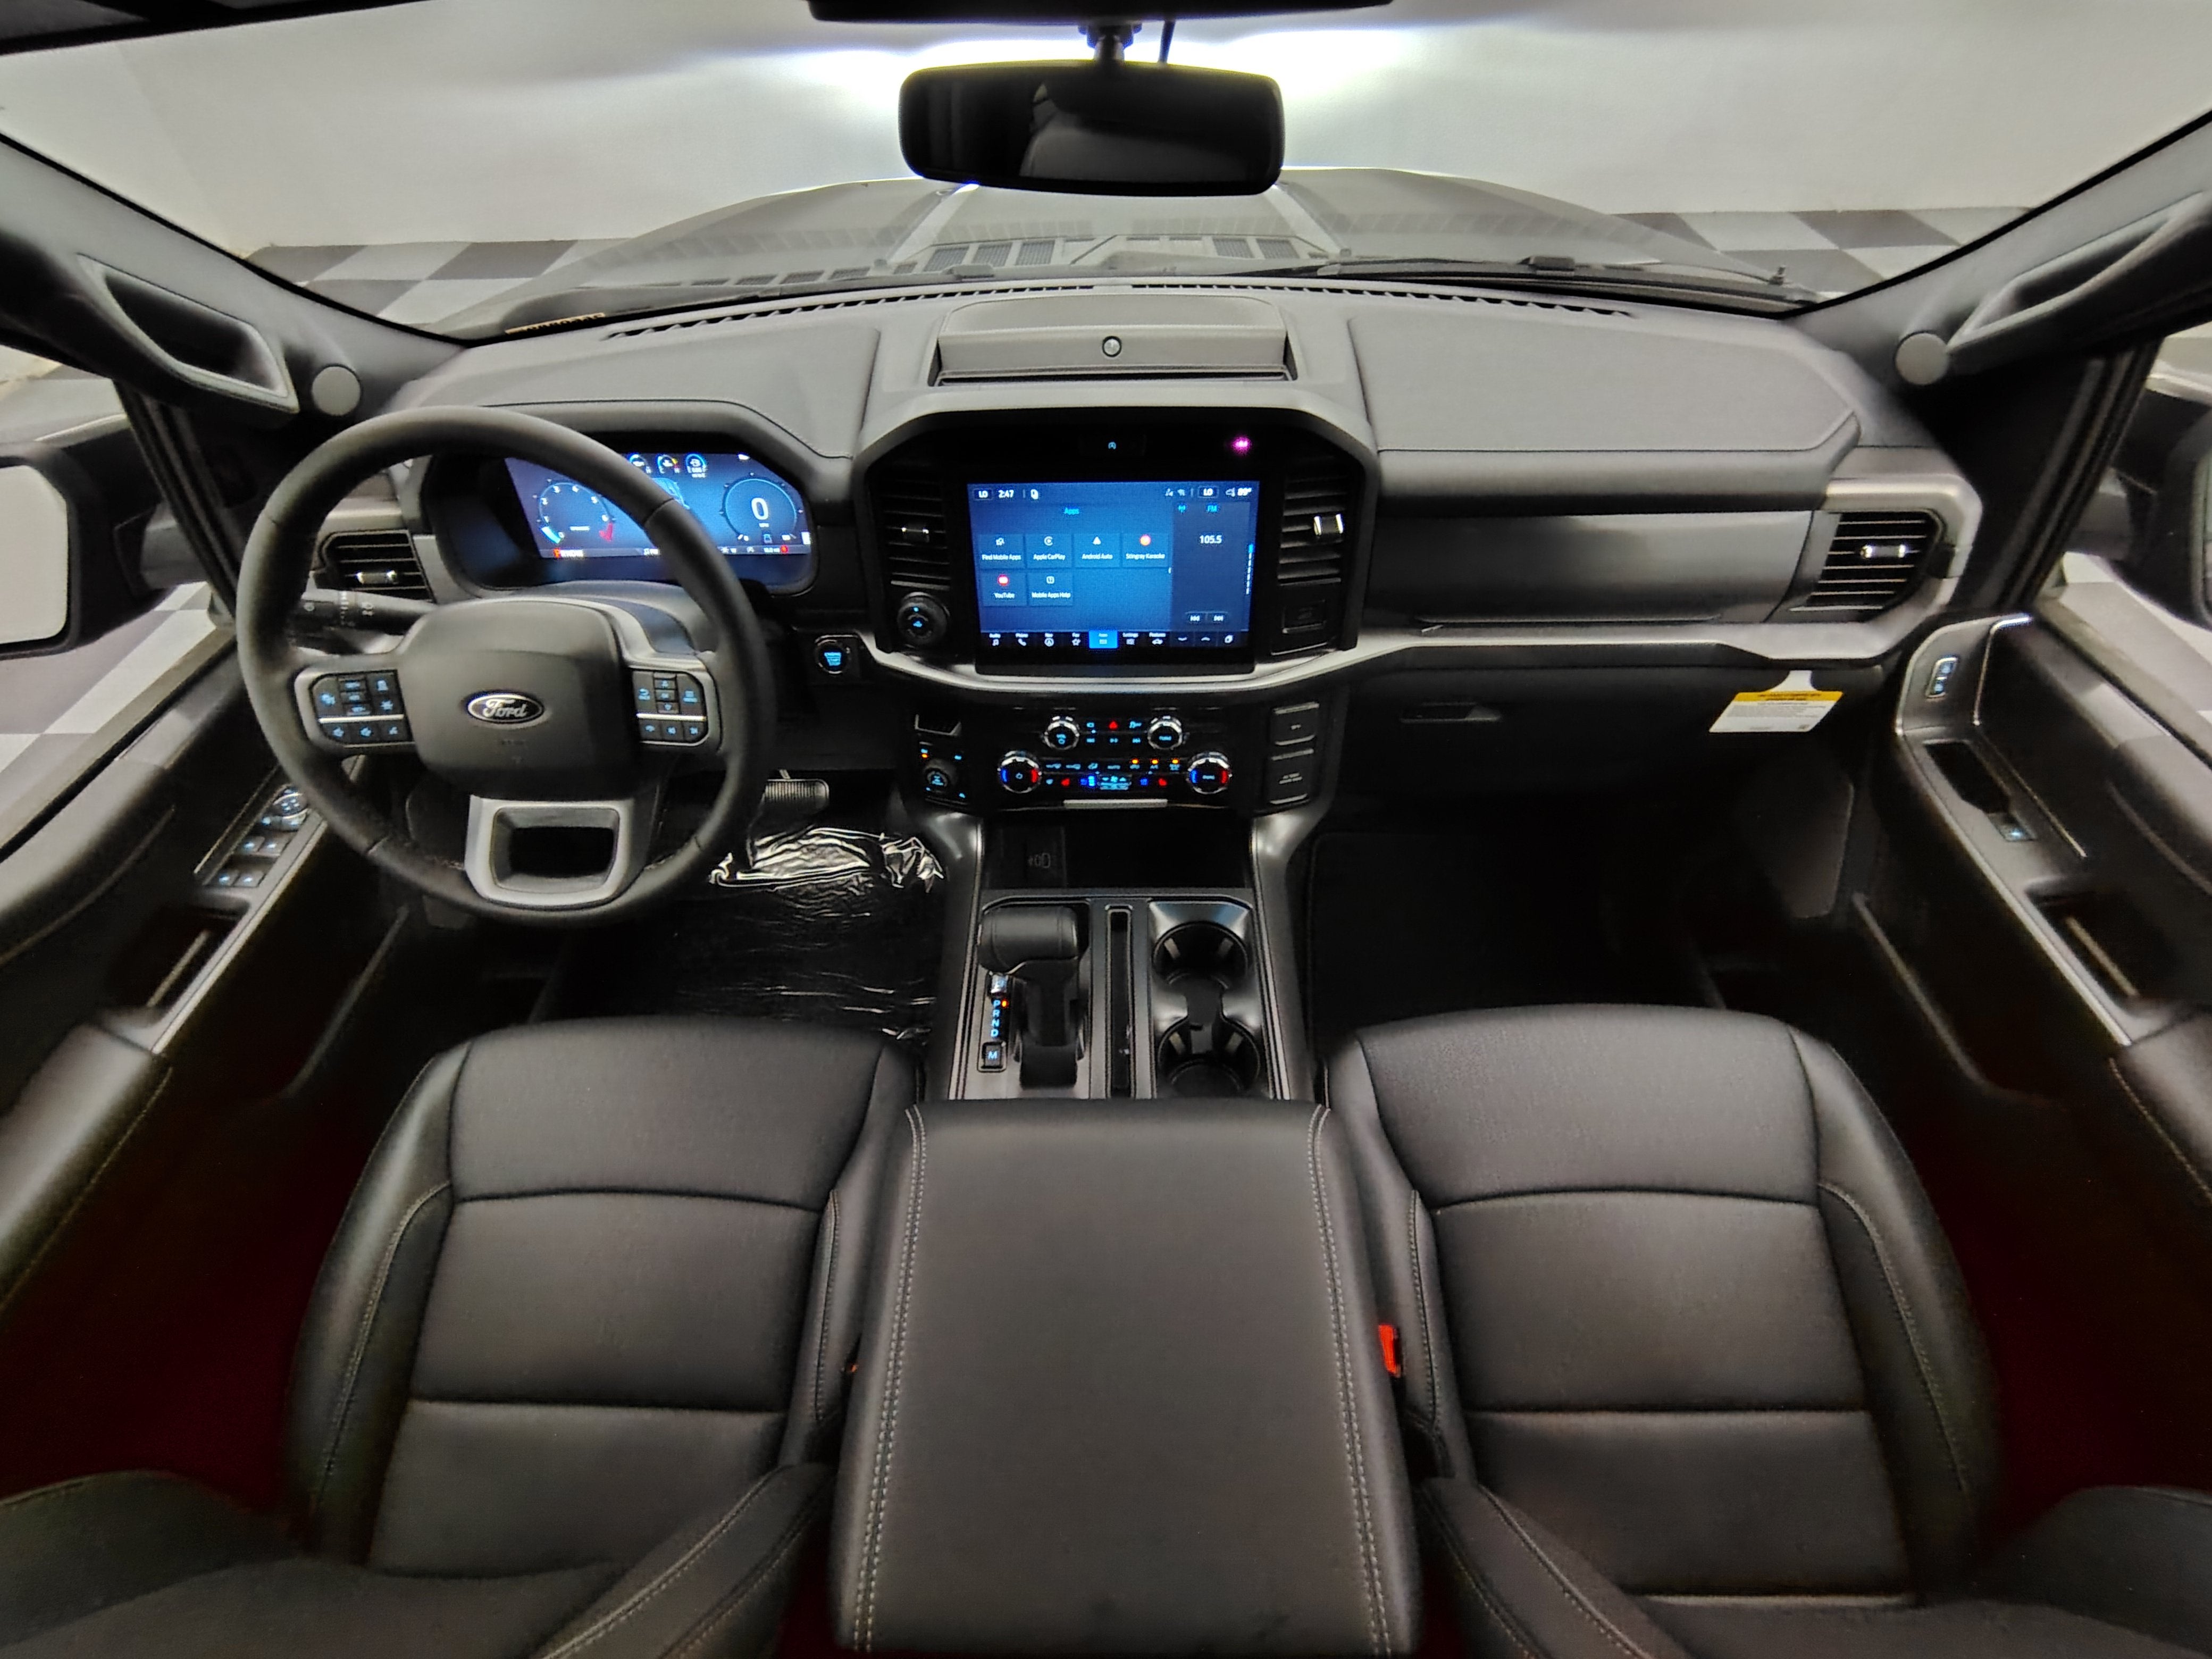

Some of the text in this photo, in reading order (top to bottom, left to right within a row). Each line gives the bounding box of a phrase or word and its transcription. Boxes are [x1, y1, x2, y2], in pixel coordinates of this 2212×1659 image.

[998, 489, 1015, 498] 2:47
[751, 498, 769, 520] 0
[1064, 507, 1079, 515] Apps
[1199, 534, 1222, 544] 105.5
[483, 698, 527, 718] Ford
[991, 1028, 999, 1037] D
[988, 1051, 998, 1059] M
